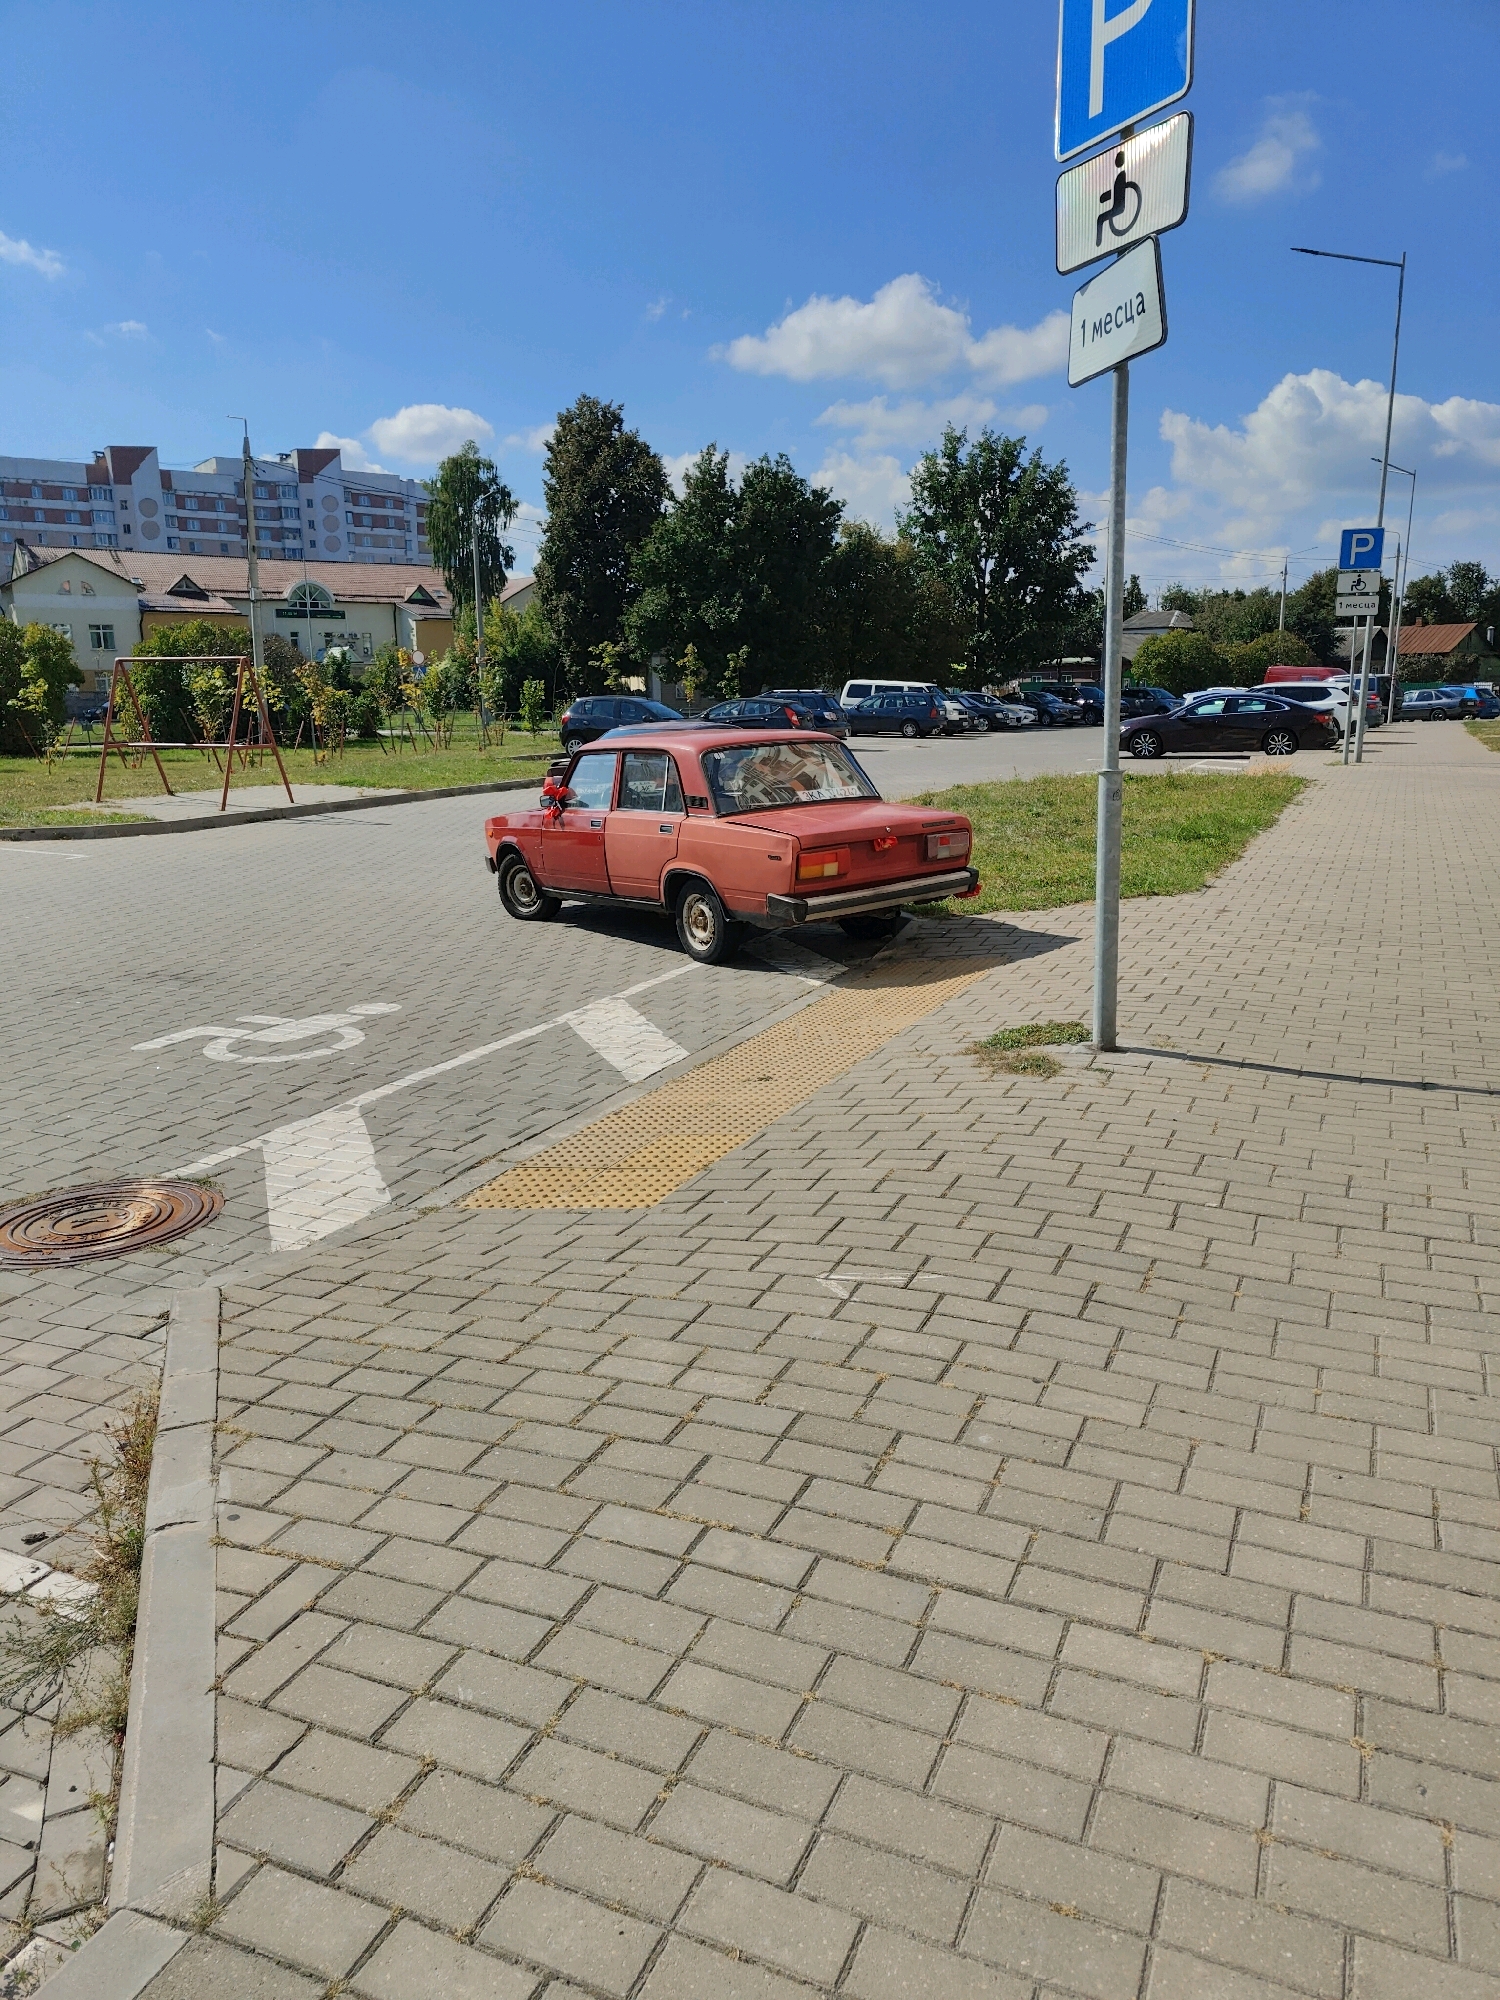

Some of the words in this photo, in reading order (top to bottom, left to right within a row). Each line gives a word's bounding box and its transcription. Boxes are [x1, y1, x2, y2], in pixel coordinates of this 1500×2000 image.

[1089, 0, 1151, 119] P
[1081, 319, 1086, 347] 1
[1092, 291, 1145, 343] месца
[1350, 533, 1374, 565] P
